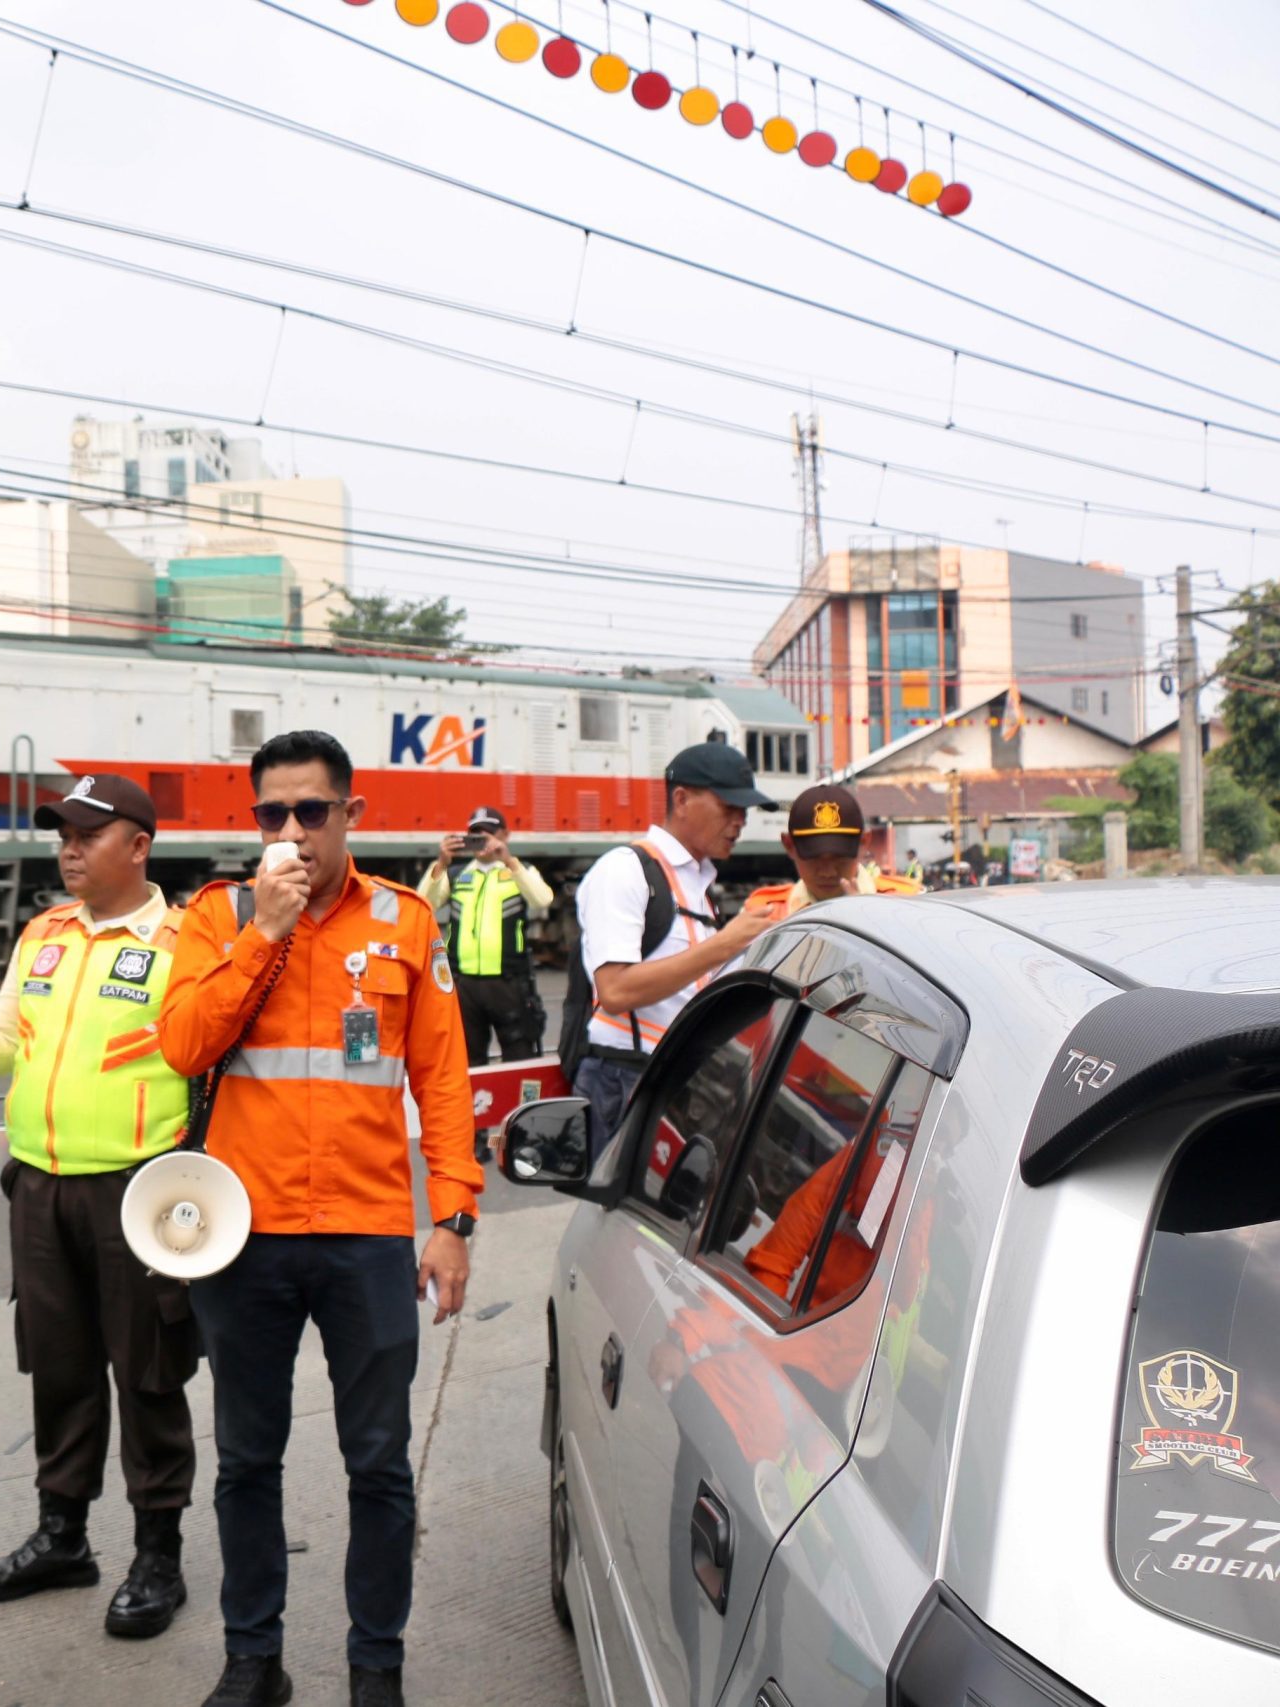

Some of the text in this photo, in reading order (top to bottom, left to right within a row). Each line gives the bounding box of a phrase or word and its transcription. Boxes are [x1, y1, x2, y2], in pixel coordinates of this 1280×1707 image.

[390, 712, 487, 767] KAI
[101, 986, 148, 1002] SATPAM
[1062, 1048, 1118, 1094] TRD
[1207, 1446, 1237, 1458] CLUB
[1148, 1510, 1280, 1553] 777
